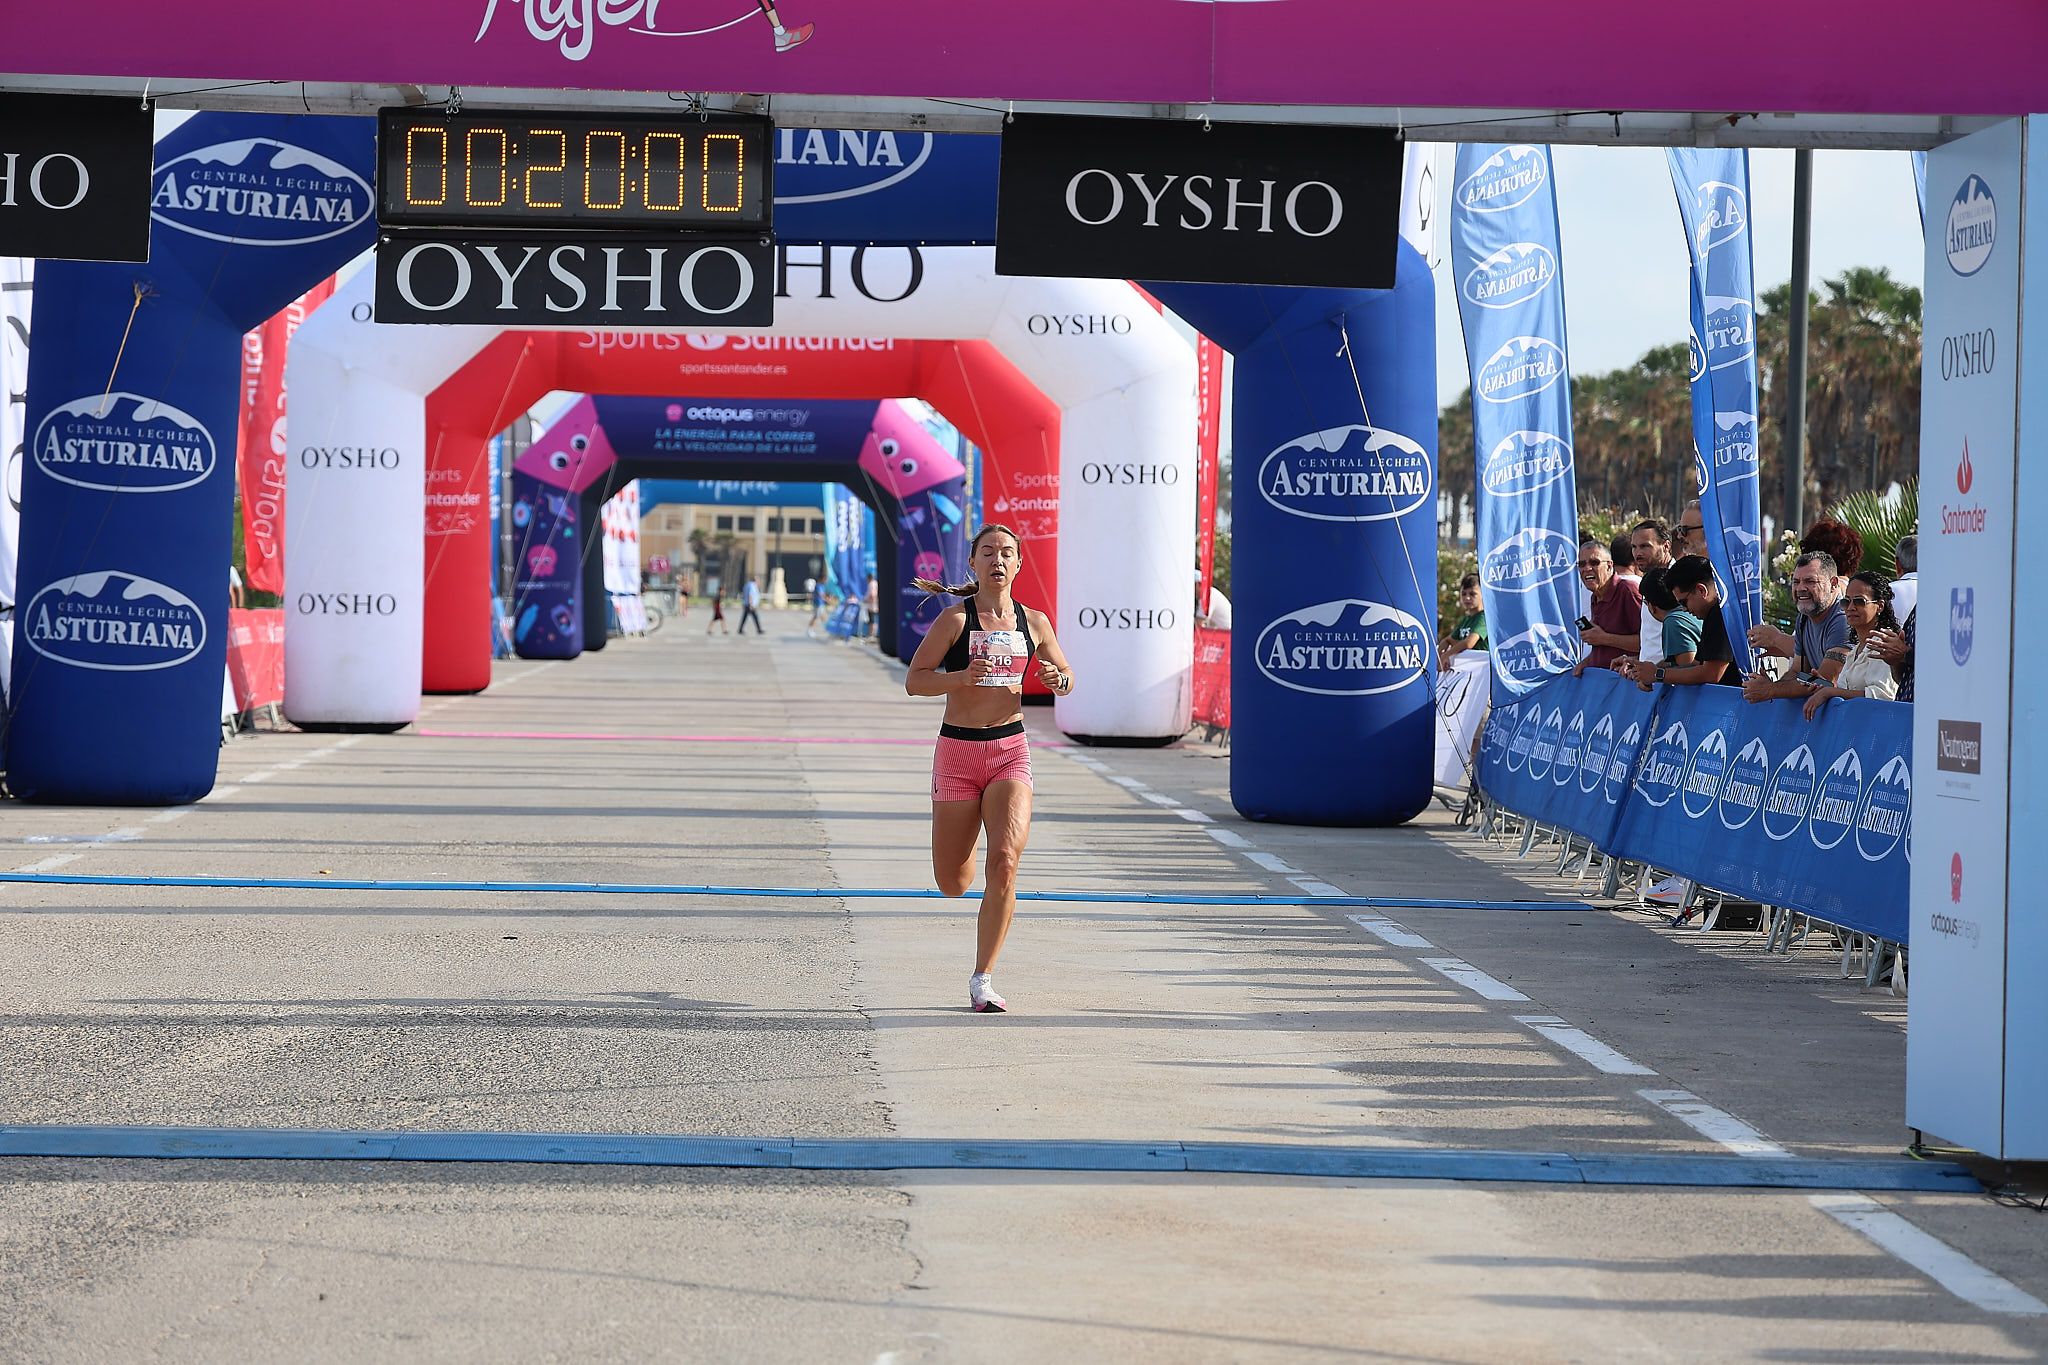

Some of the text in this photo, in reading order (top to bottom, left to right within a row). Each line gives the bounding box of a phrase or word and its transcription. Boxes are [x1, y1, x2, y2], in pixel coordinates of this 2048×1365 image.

[405, 126, 745, 212] 00:20:00
[190, 170, 353, 193] CENTRAL LECHERA
[151, 172, 355, 222] ASTURIANA
[1065, 168, 1344, 237] OYSHO
[1948, 217, 1993, 255] ASTURIANA
[396, 242, 755, 315] OYSHO
[1027, 313, 1133, 336] OYSHO
[1941, 327, 1995, 381] OYSHO
[679, 361, 788, 377] sportssantander.es
[66, 423, 201, 443] CENTRAL LECHERA
[654, 428, 672, 440] LA
[41, 425, 205, 472] ASTURIANA
[300, 446, 400, 470] OYSHO
[1081, 462, 1179, 486] OYSHO
[1298, 457, 1422, 467] CENTRAL LECHERA
[424, 469, 463, 483] ports
[1269, 460, 1425, 496] ASTURIANA
[1941, 502, 1988, 535] Santander
[57, 602, 192, 620] CENTRAL LECHERA
[297, 592, 397, 615] OYSHO
[32, 603, 195, 649] ASTURIANA
[1078, 606, 1176, 630] OYSHO
[1294, 631, 1418, 641] CENTRAL LECHERA
[1265, 633, 1422, 670] ASTURIANA
